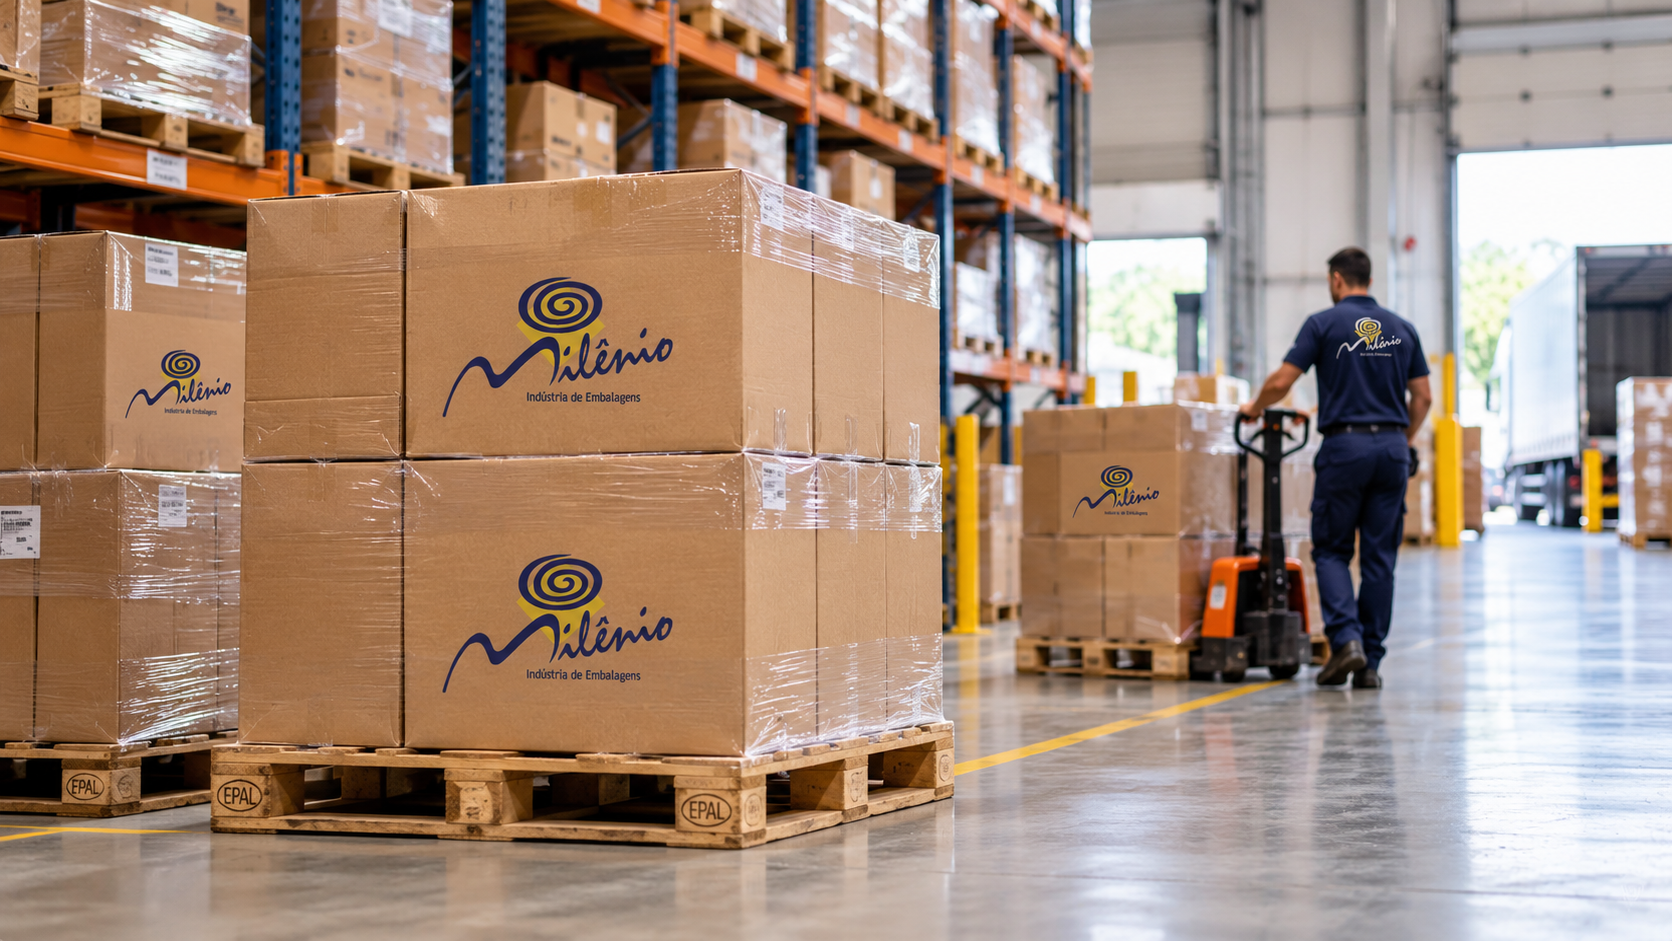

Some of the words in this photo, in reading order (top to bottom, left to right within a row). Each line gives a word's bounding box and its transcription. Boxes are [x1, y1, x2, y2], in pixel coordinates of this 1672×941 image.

[442, 327, 673, 417] Milênio
[125, 378, 231, 419] Milênio
[526, 391, 568, 402] Indústria
[571, 391, 582, 402] de
[585, 392, 641, 405] Embalagens
[1072, 486, 1159, 518] Milênio
[442, 606, 673, 693] Milênio
[526, 668, 568, 680] Indústria
[571, 669, 582, 680] de
[585, 669, 641, 683] Embalagens
[72, 779, 99, 794] EPAL
[224, 787, 257, 805] EPAL
[689, 801, 725, 820] EPAL
